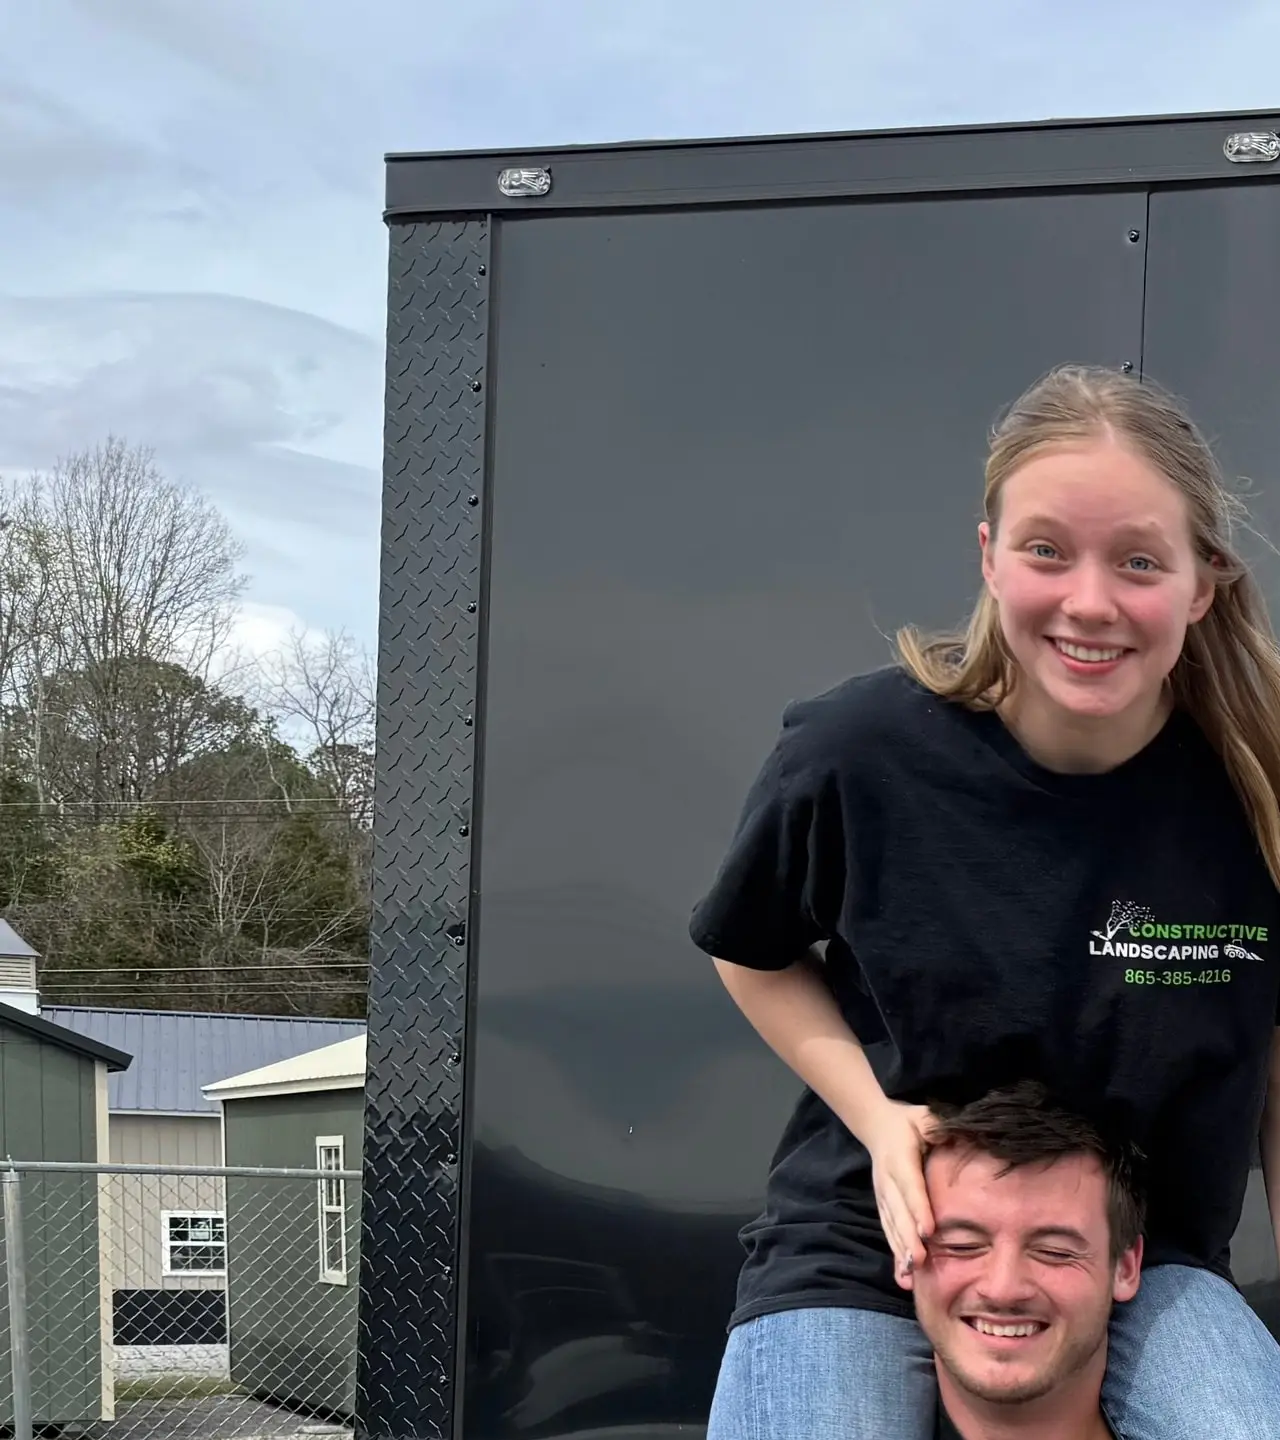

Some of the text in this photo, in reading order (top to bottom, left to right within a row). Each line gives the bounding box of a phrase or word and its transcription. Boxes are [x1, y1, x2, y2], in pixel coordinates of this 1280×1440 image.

[1129, 923, 1268, 942] CONSTRUCTIVE
[1089, 940, 1219, 960] LANDSCAPING
[1124, 969, 1231, 985] 865-385-4216
